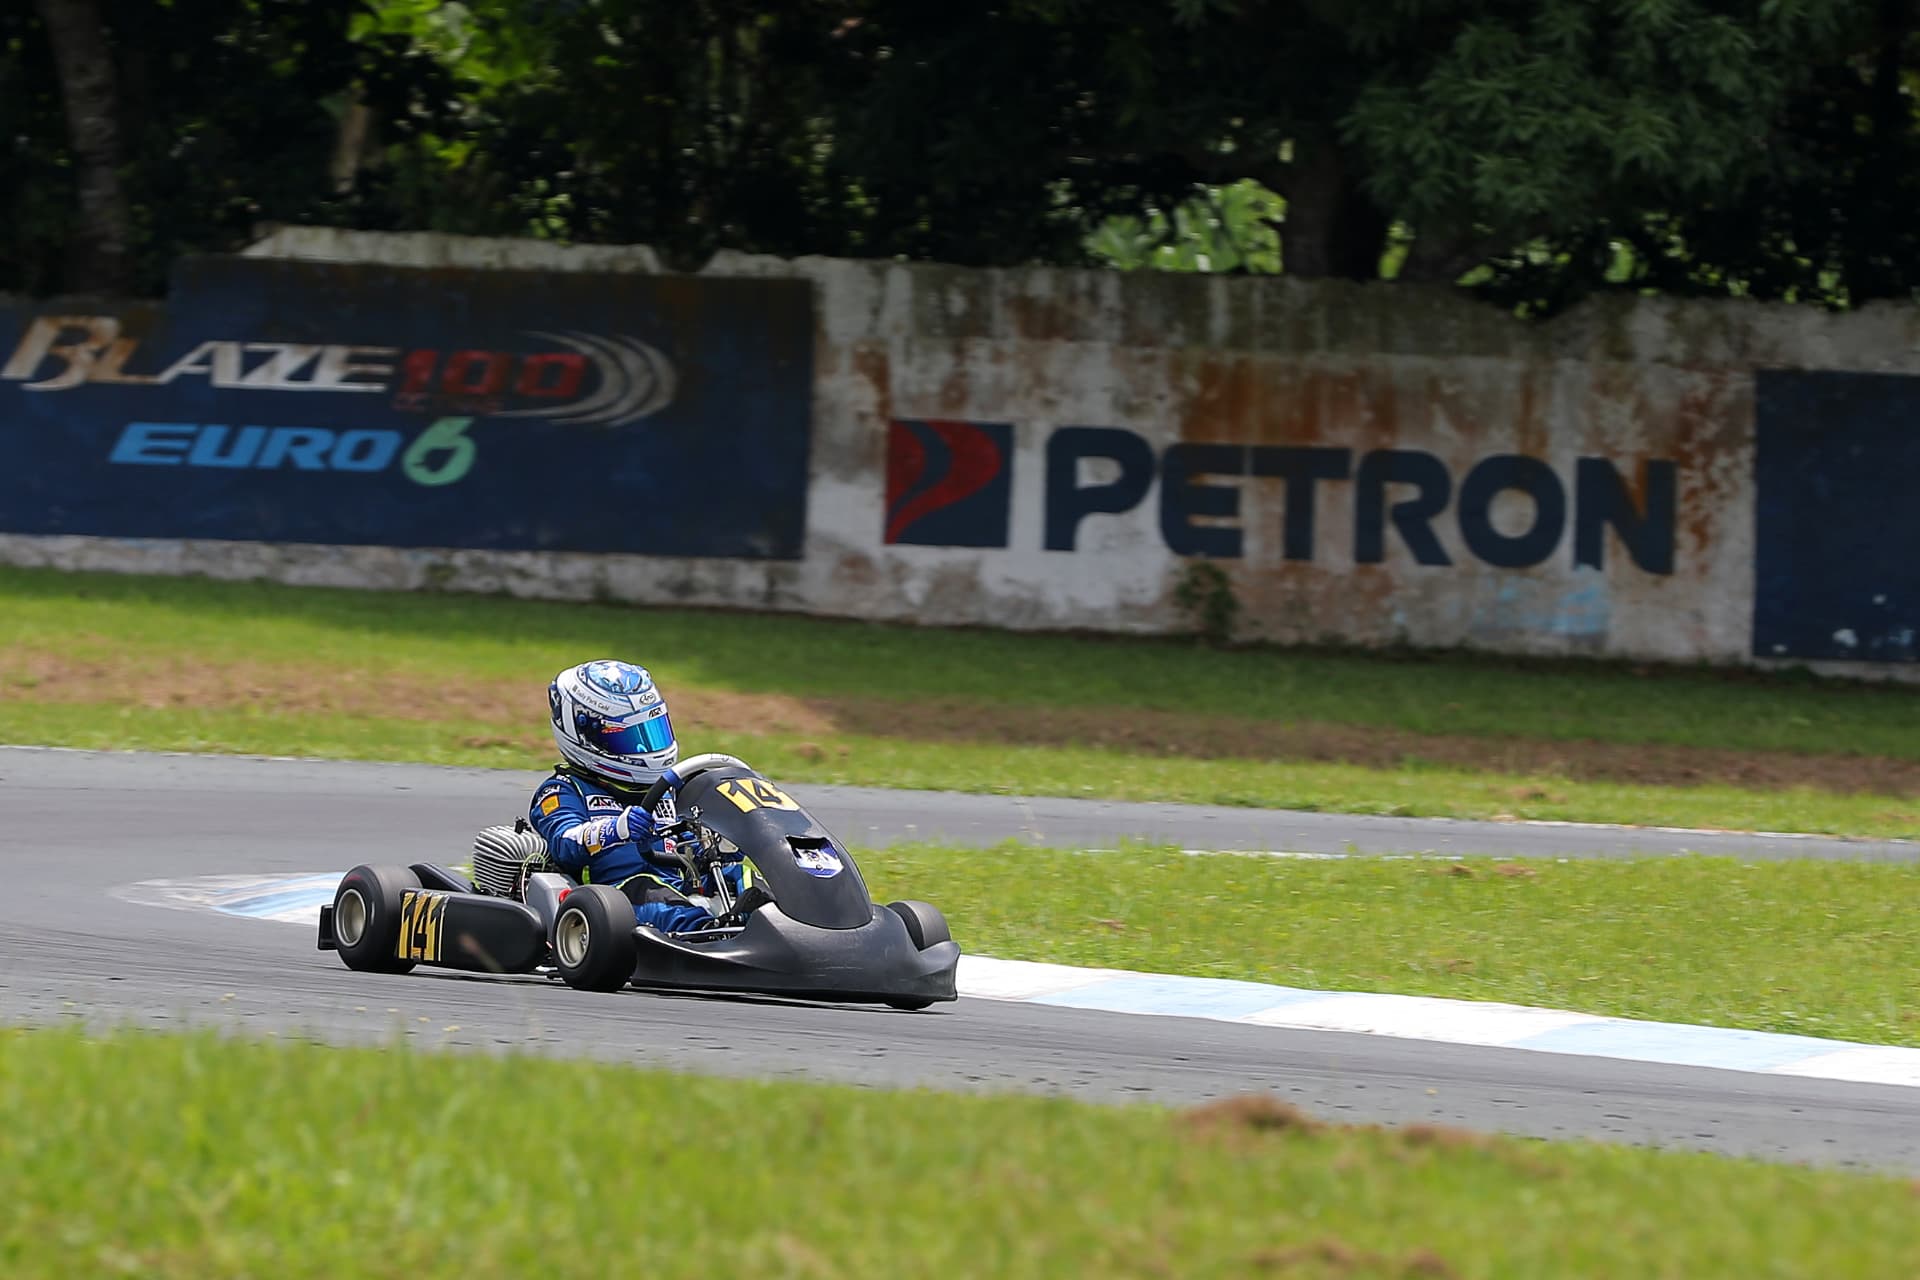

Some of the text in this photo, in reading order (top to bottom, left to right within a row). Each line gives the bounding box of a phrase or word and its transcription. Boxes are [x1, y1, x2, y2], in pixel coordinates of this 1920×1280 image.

[0, 315, 591, 397] BLAZE 100
[109, 416, 476, 486] EURO 6
[1044, 426, 1677, 575] PETRON
[717, 778, 801, 812] 14
[399, 891, 449, 961] 141
